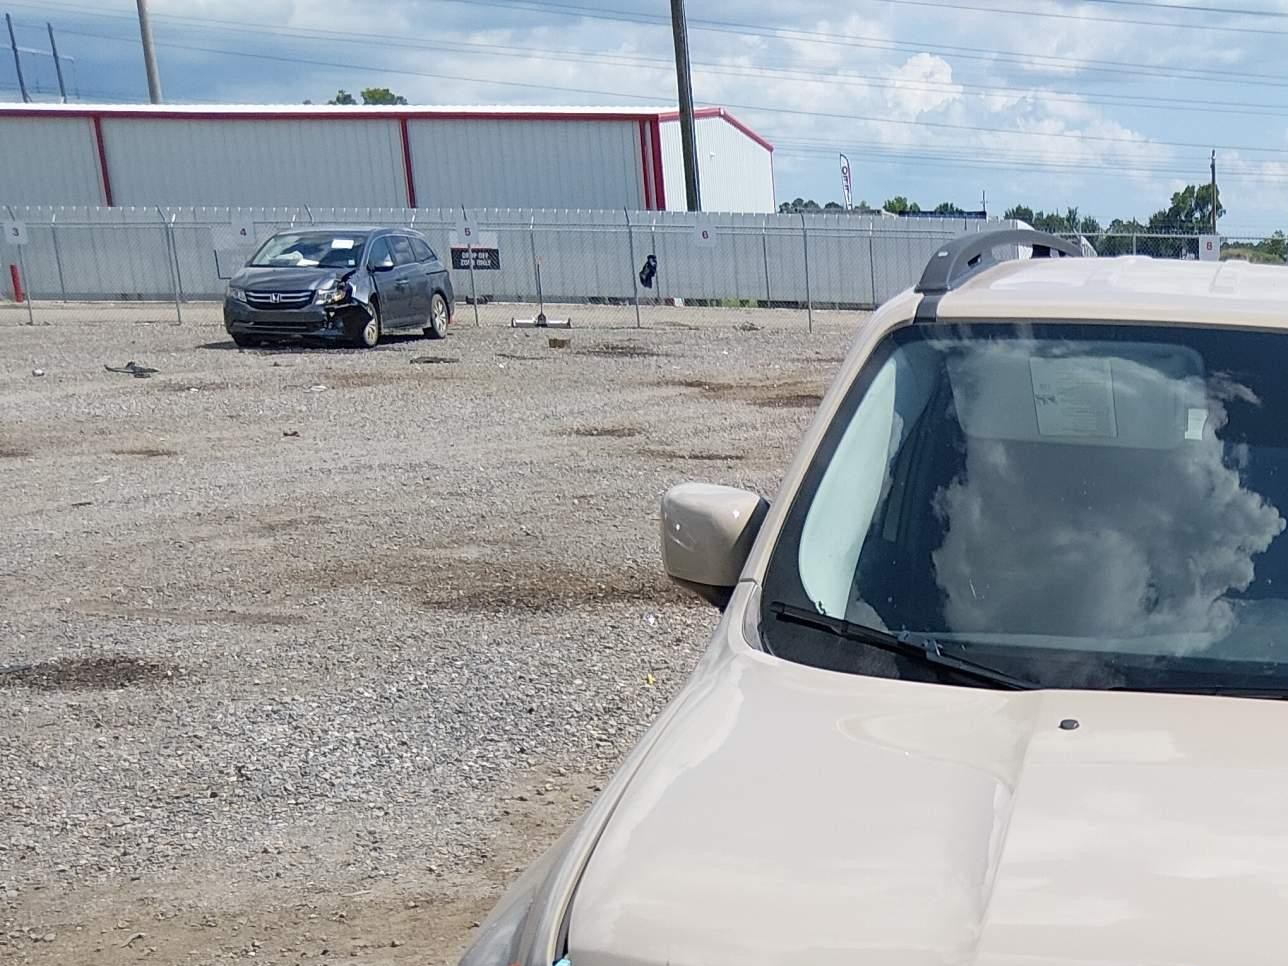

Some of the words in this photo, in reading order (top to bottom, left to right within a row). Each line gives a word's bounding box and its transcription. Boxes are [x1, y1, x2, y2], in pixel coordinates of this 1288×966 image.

[12, 227, 19, 236] 3
[240, 228, 247, 236] 4
[464, 227, 471, 237] 5
